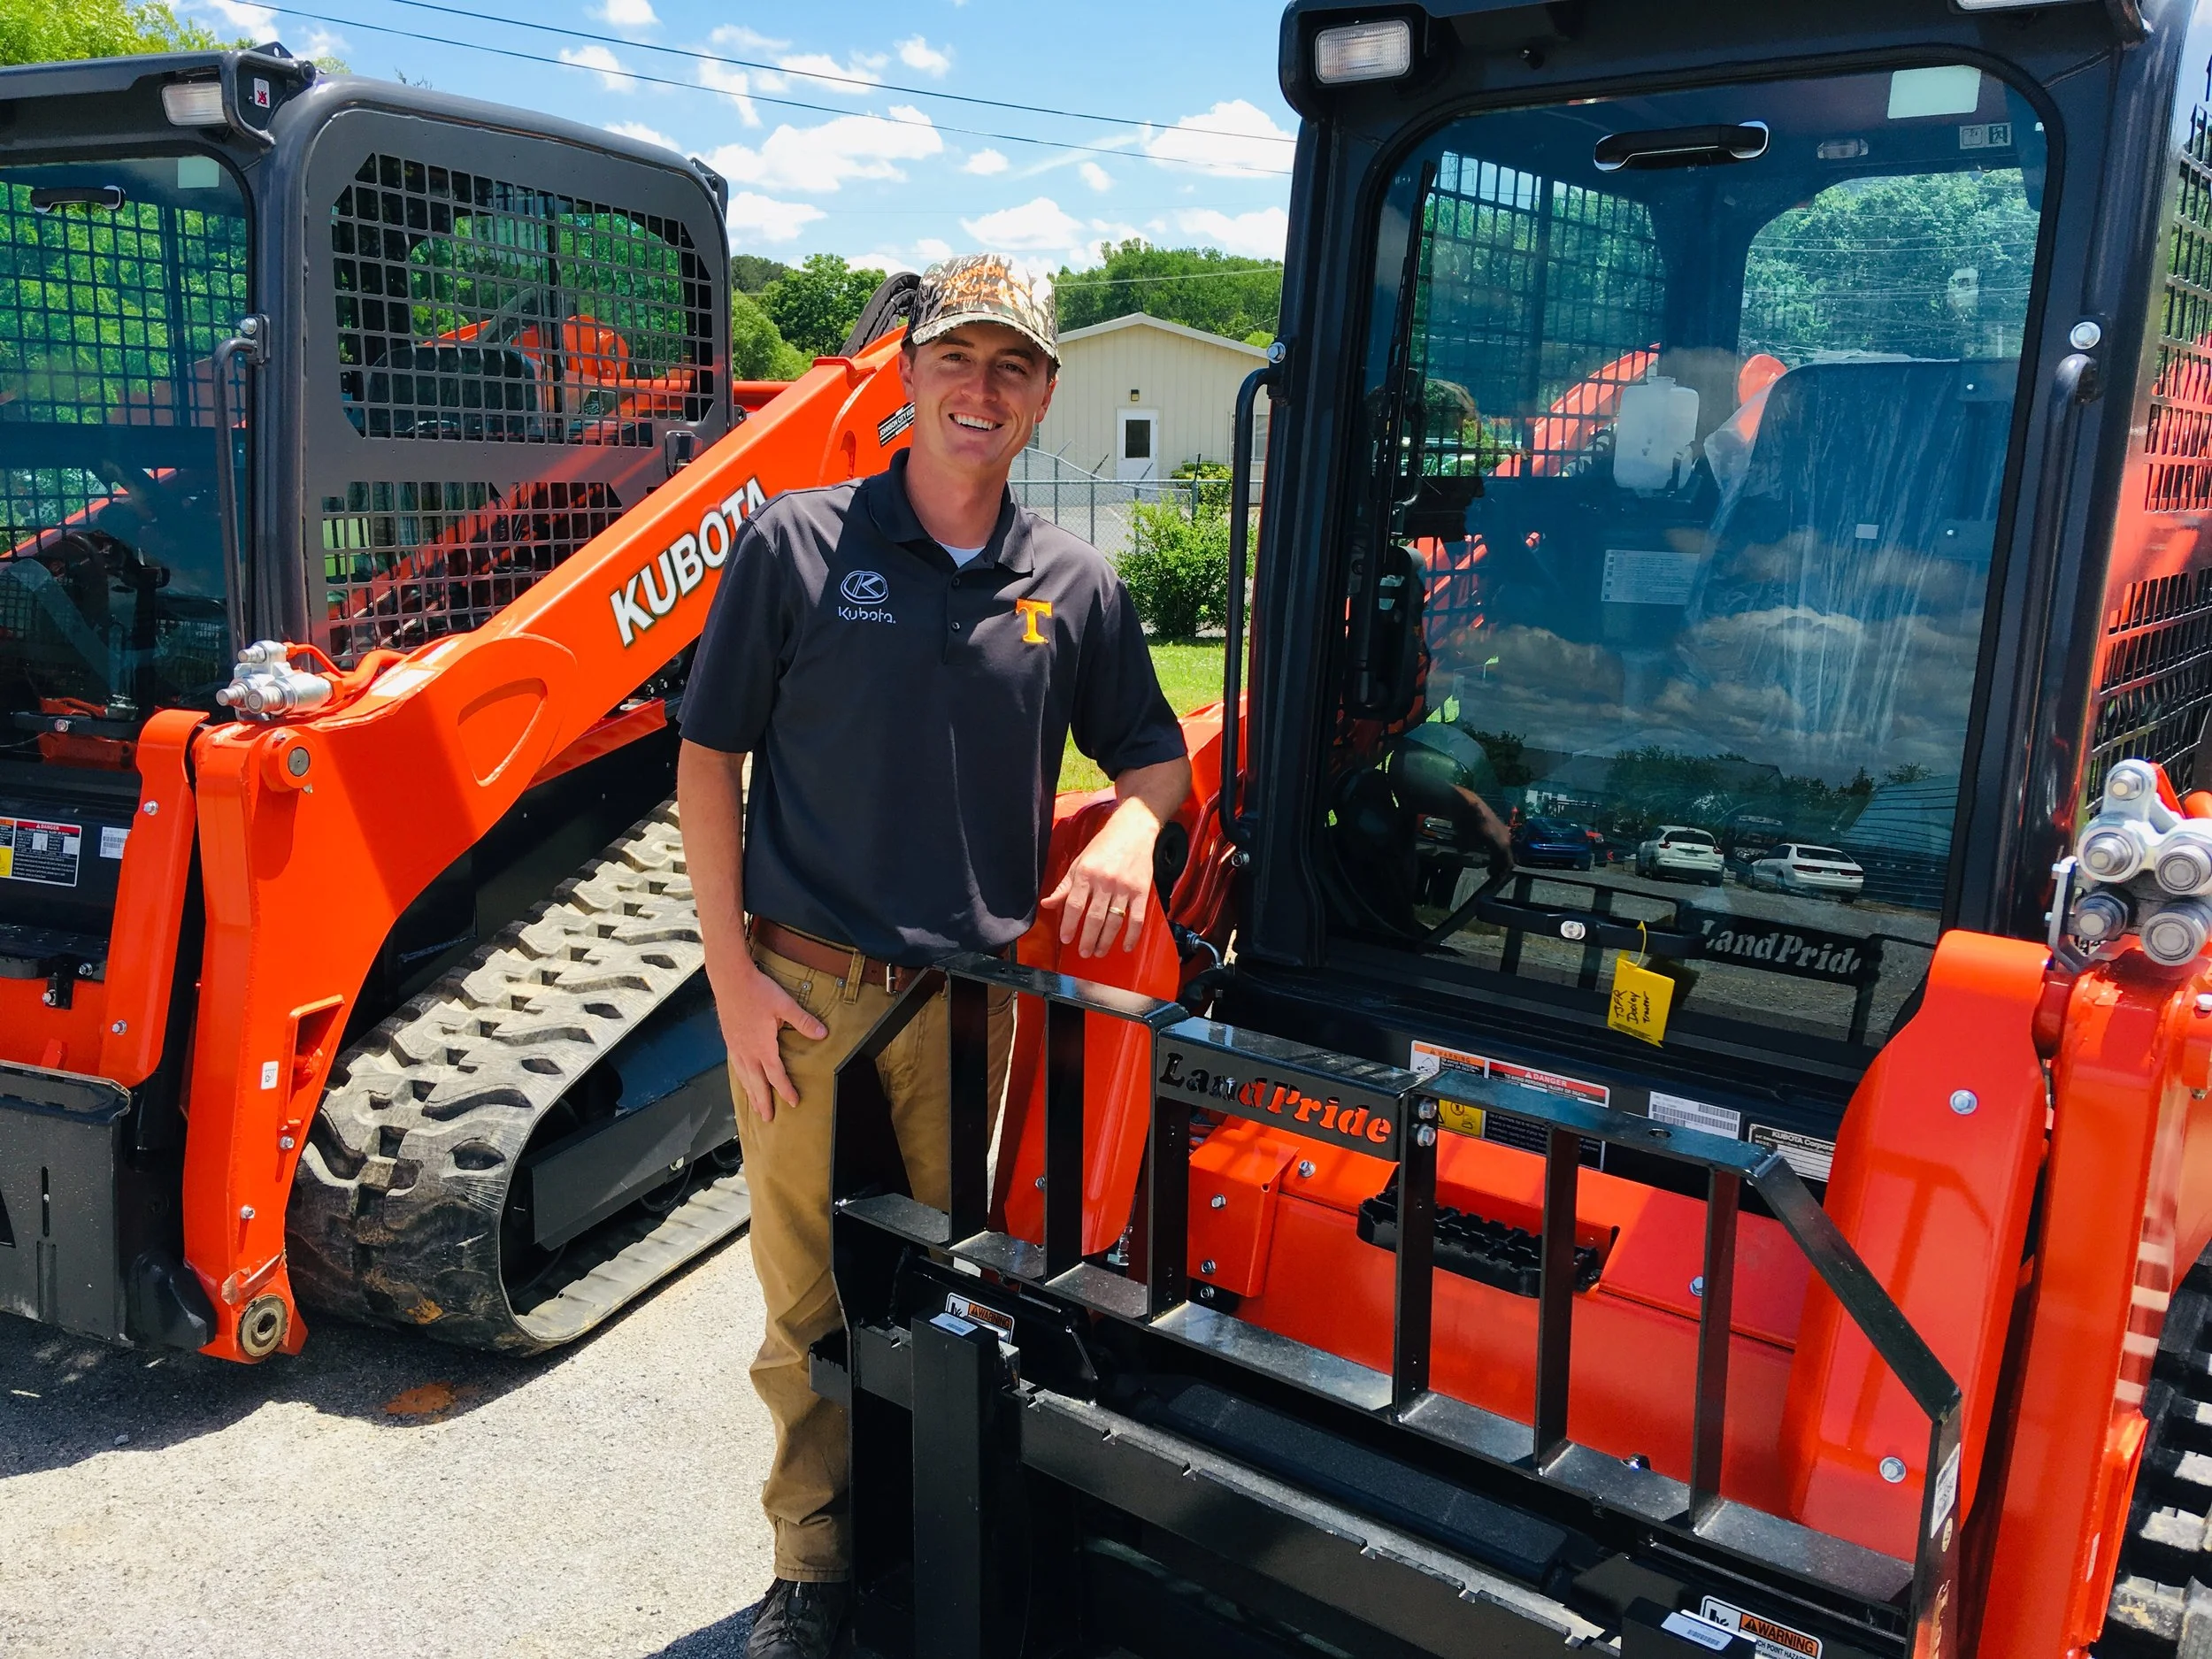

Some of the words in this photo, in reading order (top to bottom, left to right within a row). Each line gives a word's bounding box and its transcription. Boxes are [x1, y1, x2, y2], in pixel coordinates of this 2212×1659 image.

[944, 265, 1005, 290] JOHNSON
[610, 477, 766, 648] KUBOTA
[838, 606, 893, 623] Kubota
[1016, 598, 1052, 644] T
[1438, 1050, 1471, 1064] WARNING
[1532, 1073, 1567, 1087] DANGER
[1771, 1131, 1803, 1144] KUBOTA
[979, 1308, 1012, 1327] WARNING
[1758, 1621, 1815, 1654] WARNING
[1766, 1643, 1784, 1654] POINT
